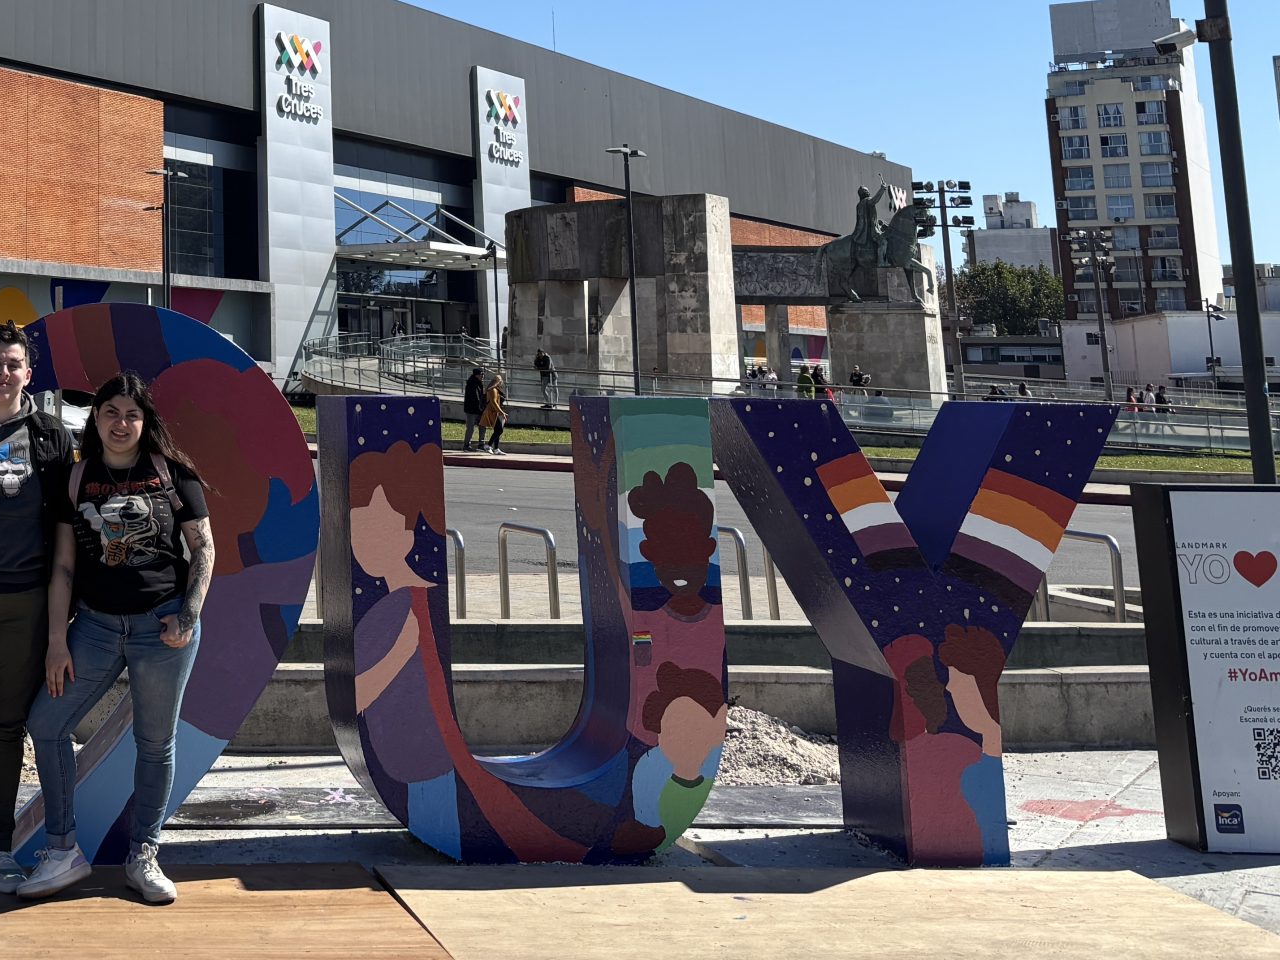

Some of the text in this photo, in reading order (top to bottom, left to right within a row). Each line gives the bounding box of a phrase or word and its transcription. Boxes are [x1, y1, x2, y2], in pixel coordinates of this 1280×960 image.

[288, 74, 316, 98] Tres
[280, 93, 324, 120] Cruces
[497, 125, 517, 145] Tres
[491, 141, 524, 163] Cruces
[1177, 553, 1231, 585] YO
[1188, 610, 1206, 619] Esta
[1236, 610, 1274, 619] iniciativa
[1208, 624, 1216, 632] el
[1217, 624, 1229, 632] fin
[1230, 624, 1240, 632] de
[1190, 637, 1222, 645] cultural
[1230, 637, 1256, 645] través
[1258, 638, 1269, 646] de
[1203, 652, 1208, 660] y
[1257, 651, 1266, 659] el
[1239, 715, 1268, 723] Escaneá
[1212, 789, 1241, 798] Apoyan:
